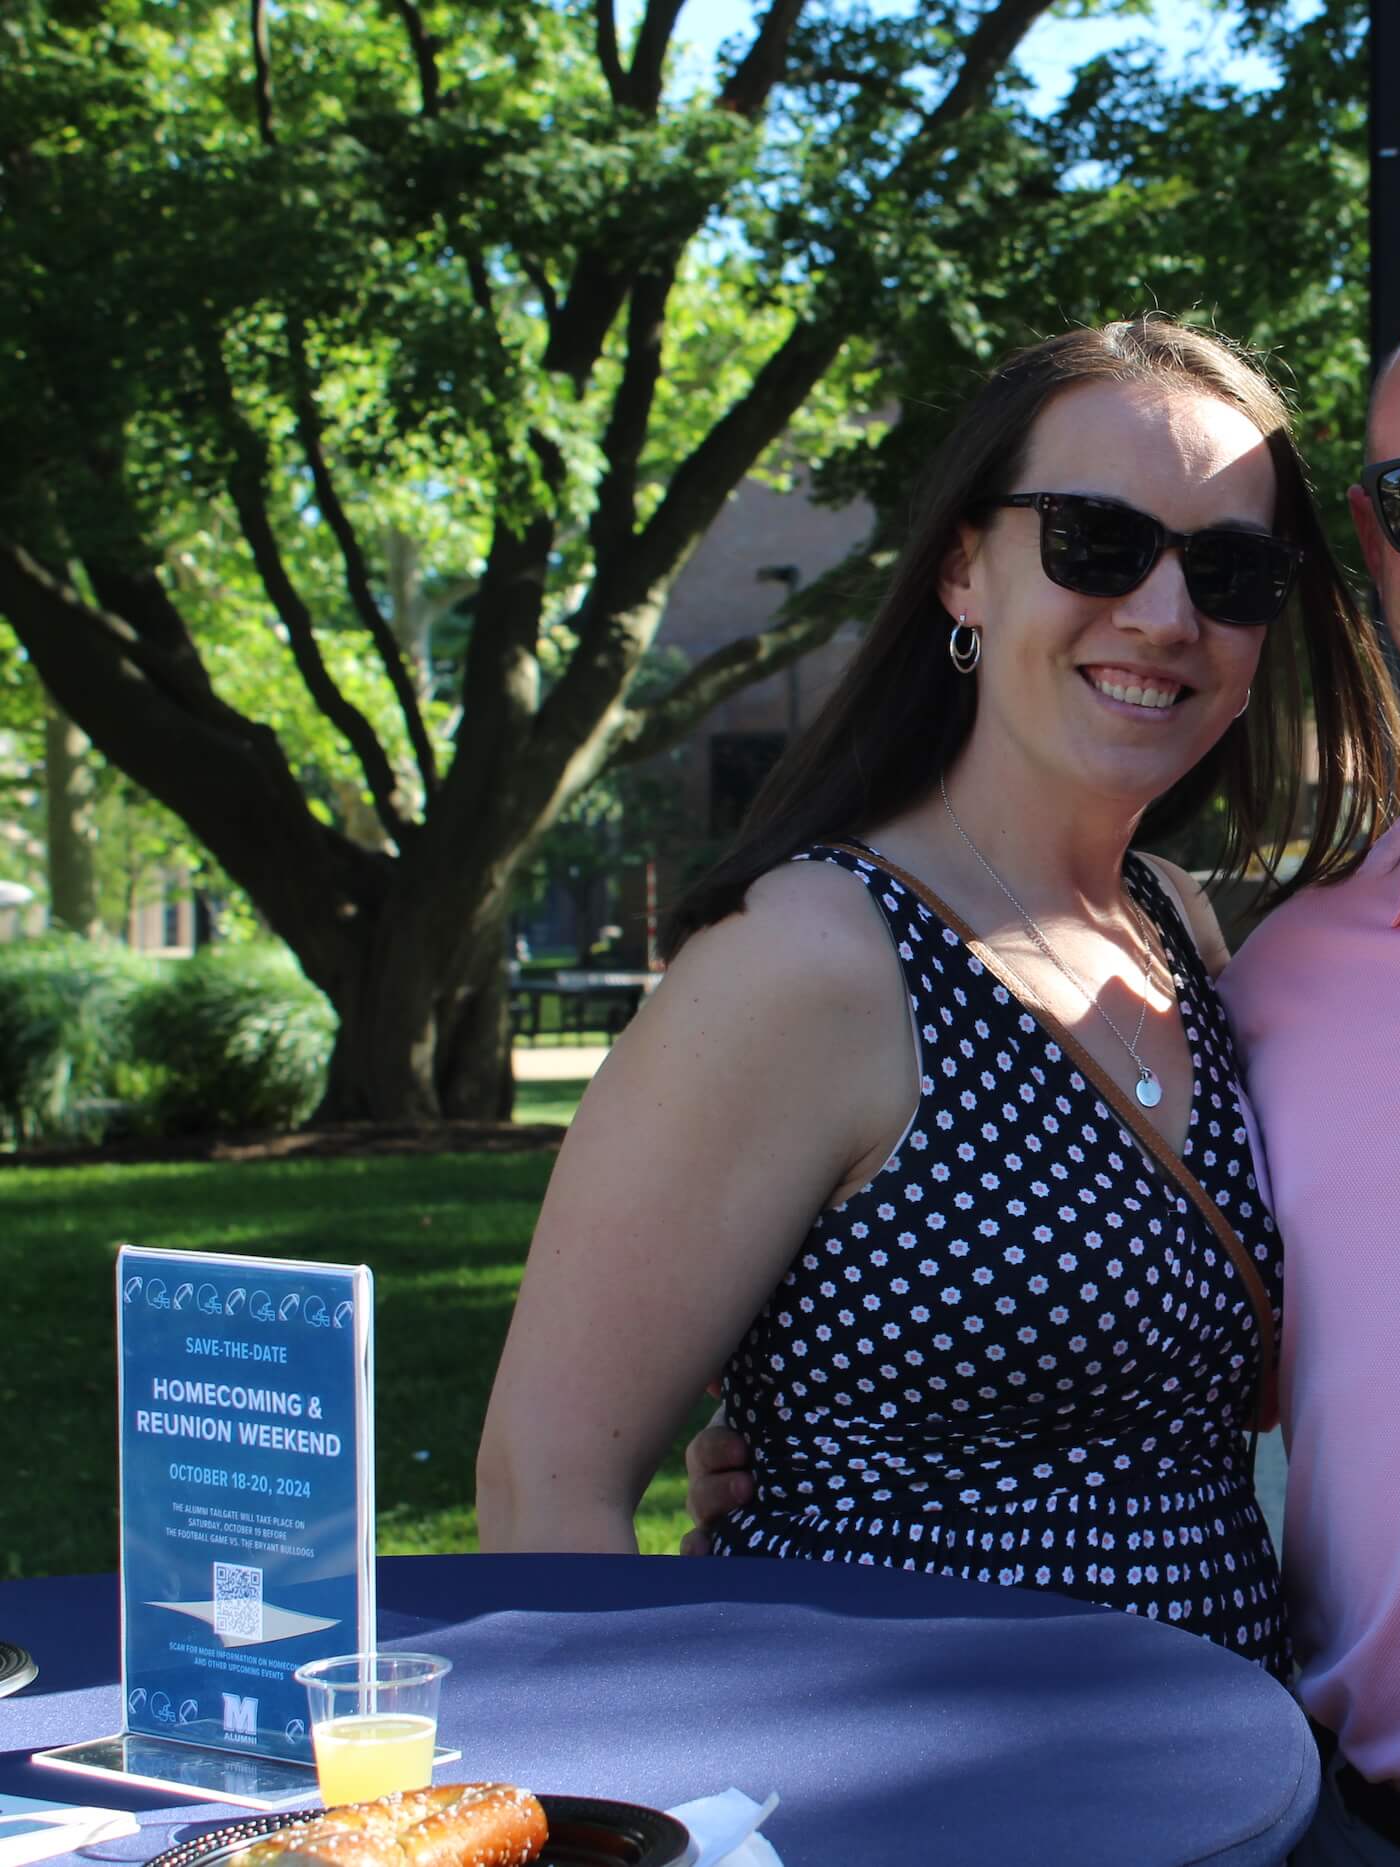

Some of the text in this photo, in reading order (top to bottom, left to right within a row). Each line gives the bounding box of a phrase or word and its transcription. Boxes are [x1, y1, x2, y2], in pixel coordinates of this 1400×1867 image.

[186, 1337, 287, 1363] SAVE-THE-DATE
[153, 1378, 322, 1419] HOMECOMING &
[137, 1410, 341, 1457] REUNION WEEKEND
[170, 1463, 311, 1498] OCTOBER 18-20, 2024
[172, 1502, 305, 1530] THE ALUMNI TAILGATE WILL TAKE PLACE ON
[188, 1518, 287, 1541] SATURDAY, OCTOBER 19 BEFORE
[166, 1527, 315, 1558] THE FOOTBALL GAME VS. THE BRYANT BULLDOGS
[169, 1641, 185, 1652] SCAN
[186, 1645, 198, 1654] FOR
[199, 1647, 215, 1657] MORE
[216, 1651, 257, 1666] INFORMATION
[259, 1656, 267, 1666] ON
[194, 1657, 284, 1680] AND OTHER UPCOMING EVENTS
[222, 1692, 259, 1735] M
[224, 1733, 257, 1745] ALUMNI
